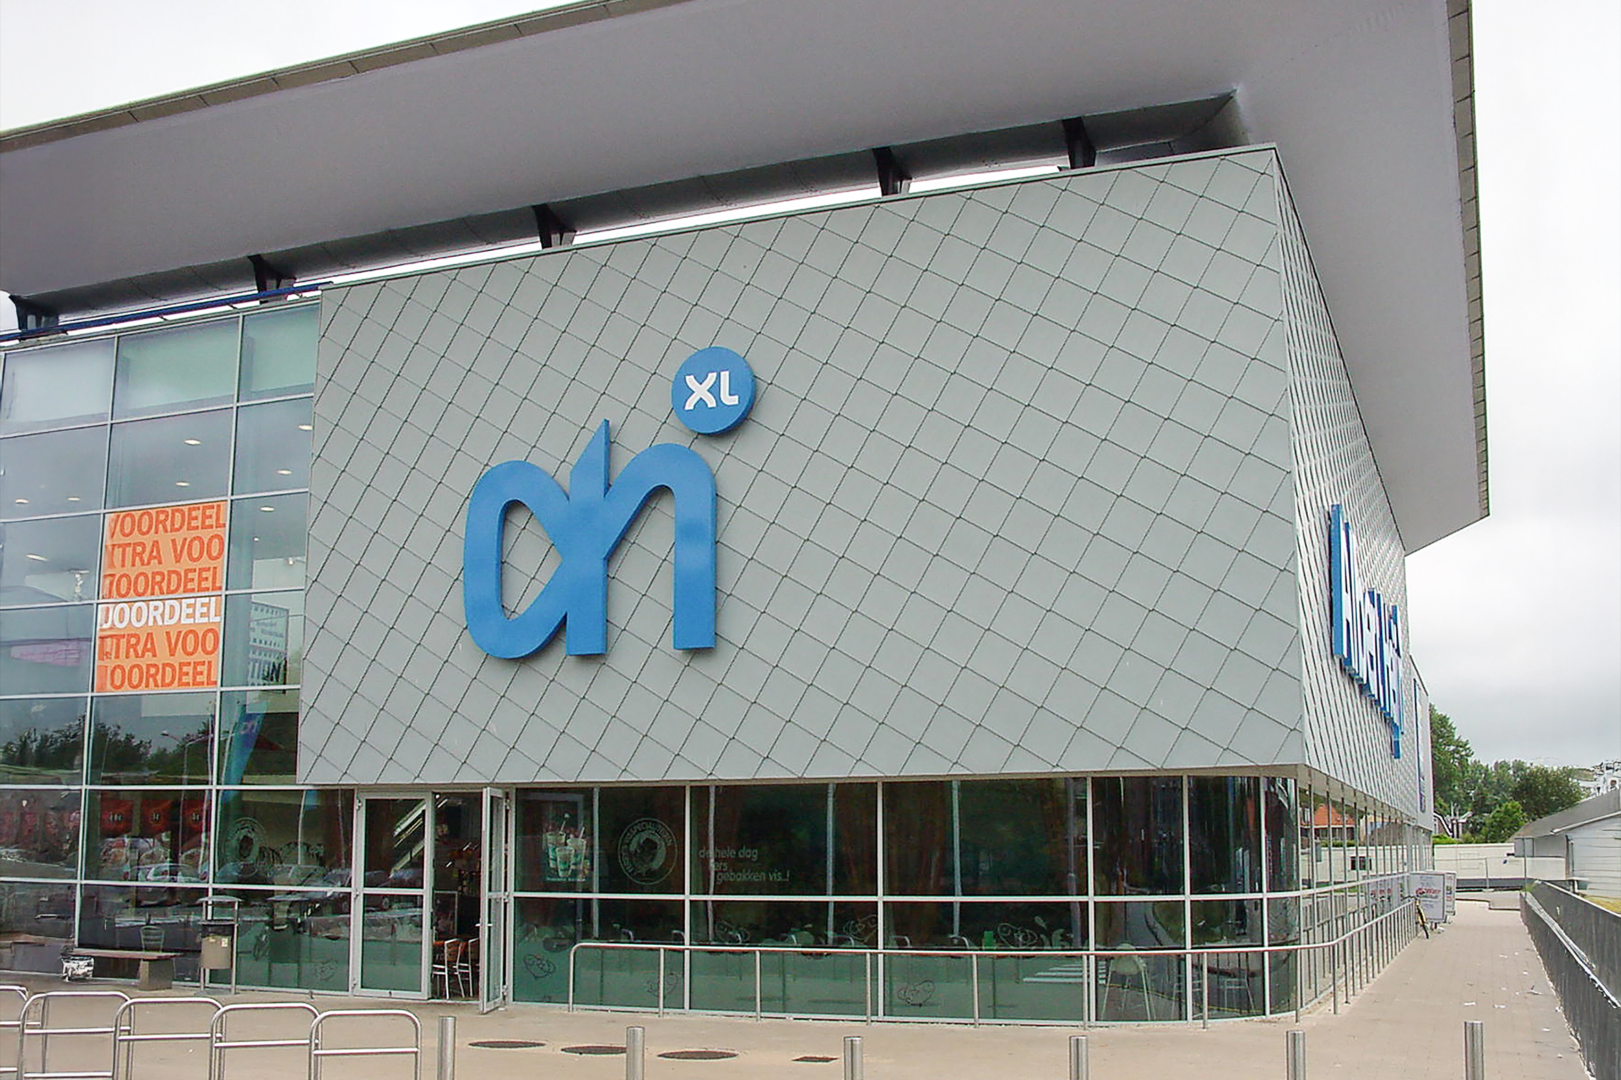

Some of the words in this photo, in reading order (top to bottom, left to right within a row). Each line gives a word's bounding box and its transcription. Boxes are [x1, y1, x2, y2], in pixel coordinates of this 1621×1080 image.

[684, 370, 739, 411] XL
[171, 534, 225, 564] VOO
[98, 632, 158, 661] TRA
[165, 628, 220, 657] VOO
[96, 660, 218, 691] OORDEEL
[738, 844, 759, 861] dag
